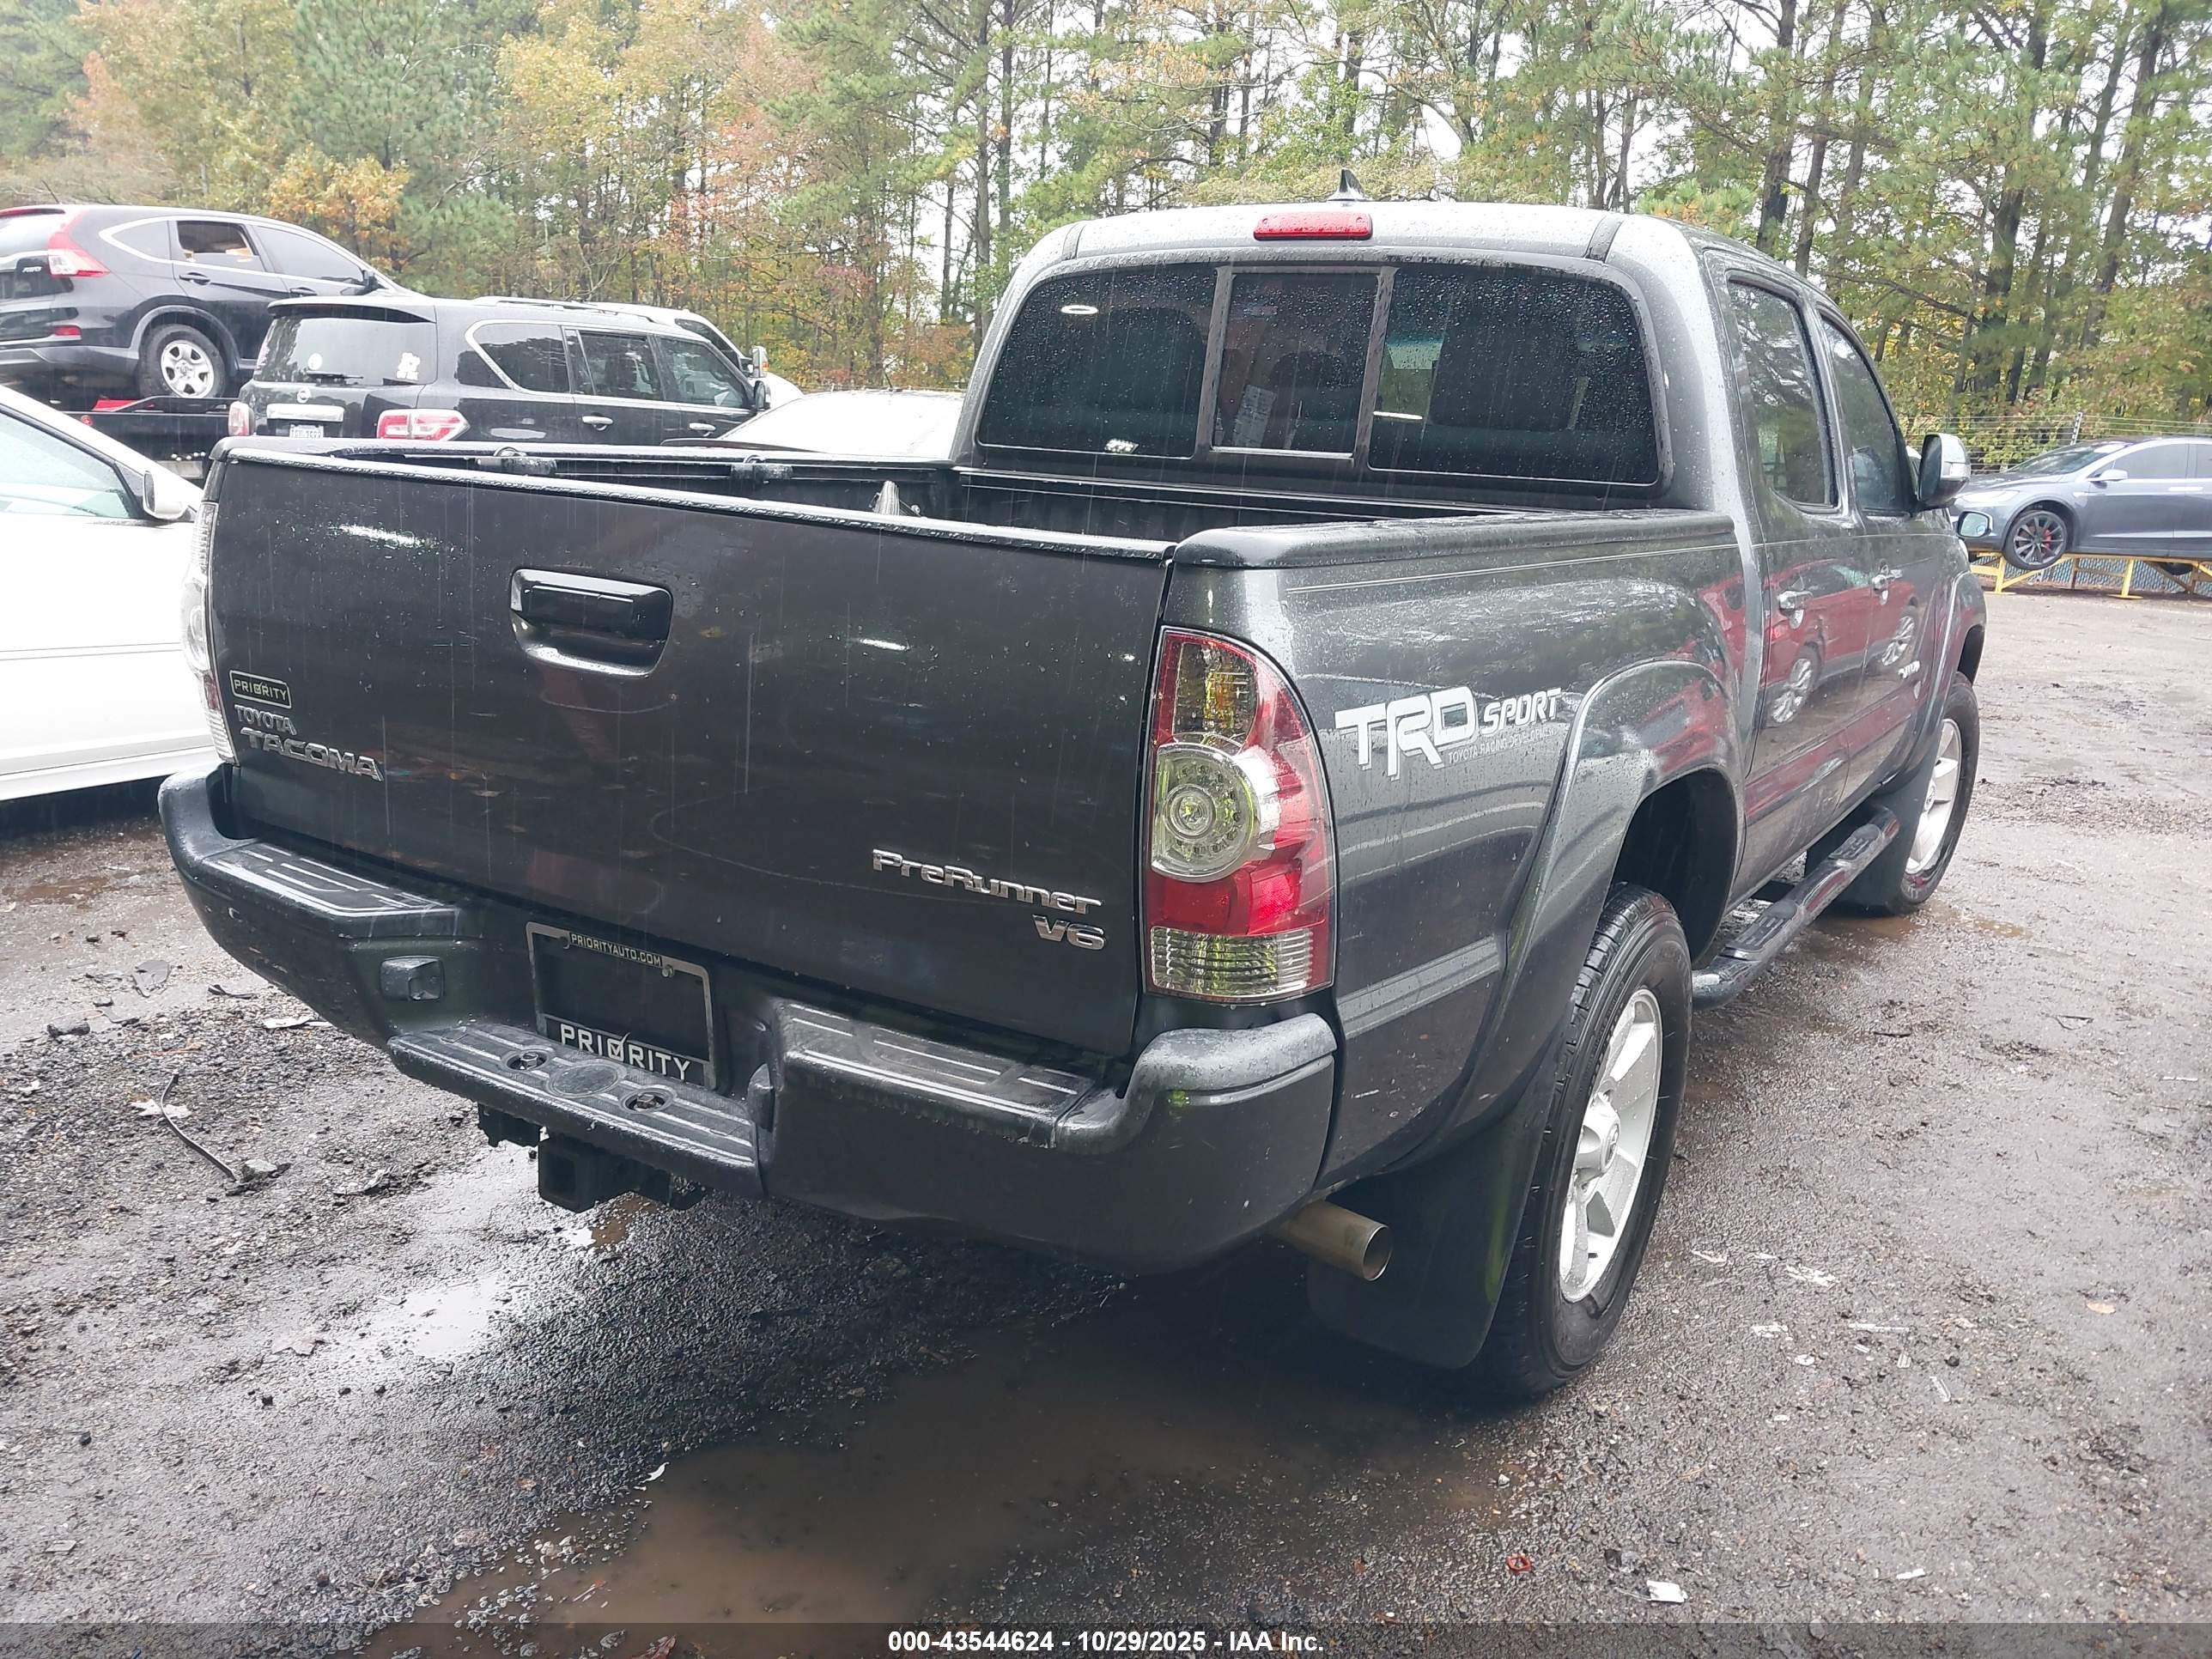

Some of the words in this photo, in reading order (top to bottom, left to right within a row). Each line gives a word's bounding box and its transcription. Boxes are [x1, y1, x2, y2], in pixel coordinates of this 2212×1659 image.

[234, 678, 288, 701] PRIORITY
[234, 704, 298, 736] TOYOTA
[1334, 686, 1478, 781] TRD
[1480, 687, 1562, 735] SPORT
[240, 727, 385, 782] TACOMA
[1448, 745, 1478, 764] TOYOTA
[1480, 738, 1509, 757] RACING
[872, 848, 1102, 915] PreRunner
[571, 933, 662, 967] PRIORITYAUTO.COM
[1032, 914, 1106, 951] V6
[560, 1023, 690, 1081] PRIORITY
